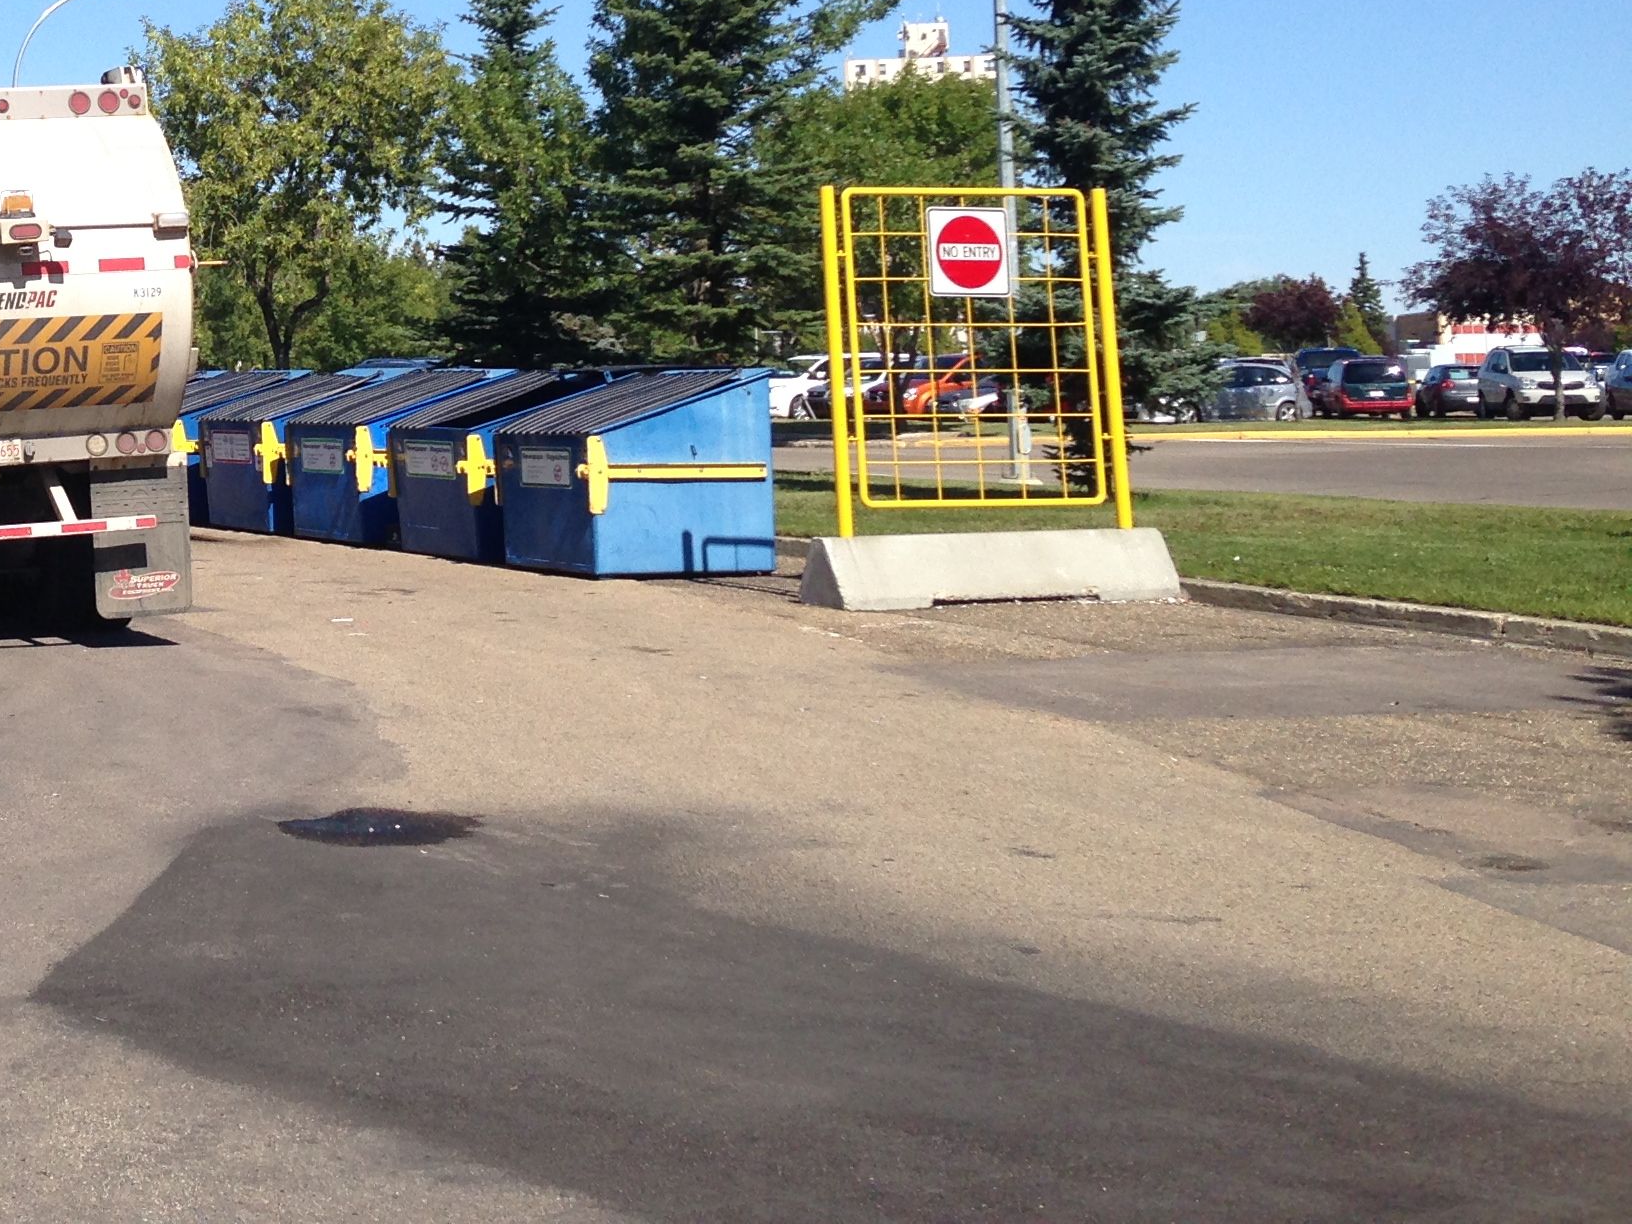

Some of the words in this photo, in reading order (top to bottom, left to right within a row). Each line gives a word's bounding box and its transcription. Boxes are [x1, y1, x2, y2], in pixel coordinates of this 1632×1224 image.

[942, 245, 958, 257] NO
[963, 246, 996, 258] ENTRY
[21, 374, 88, 388] FREQUENTLY
[0, 445, 20, 457] 655
[129, 574, 177, 585] SUPERIOR
